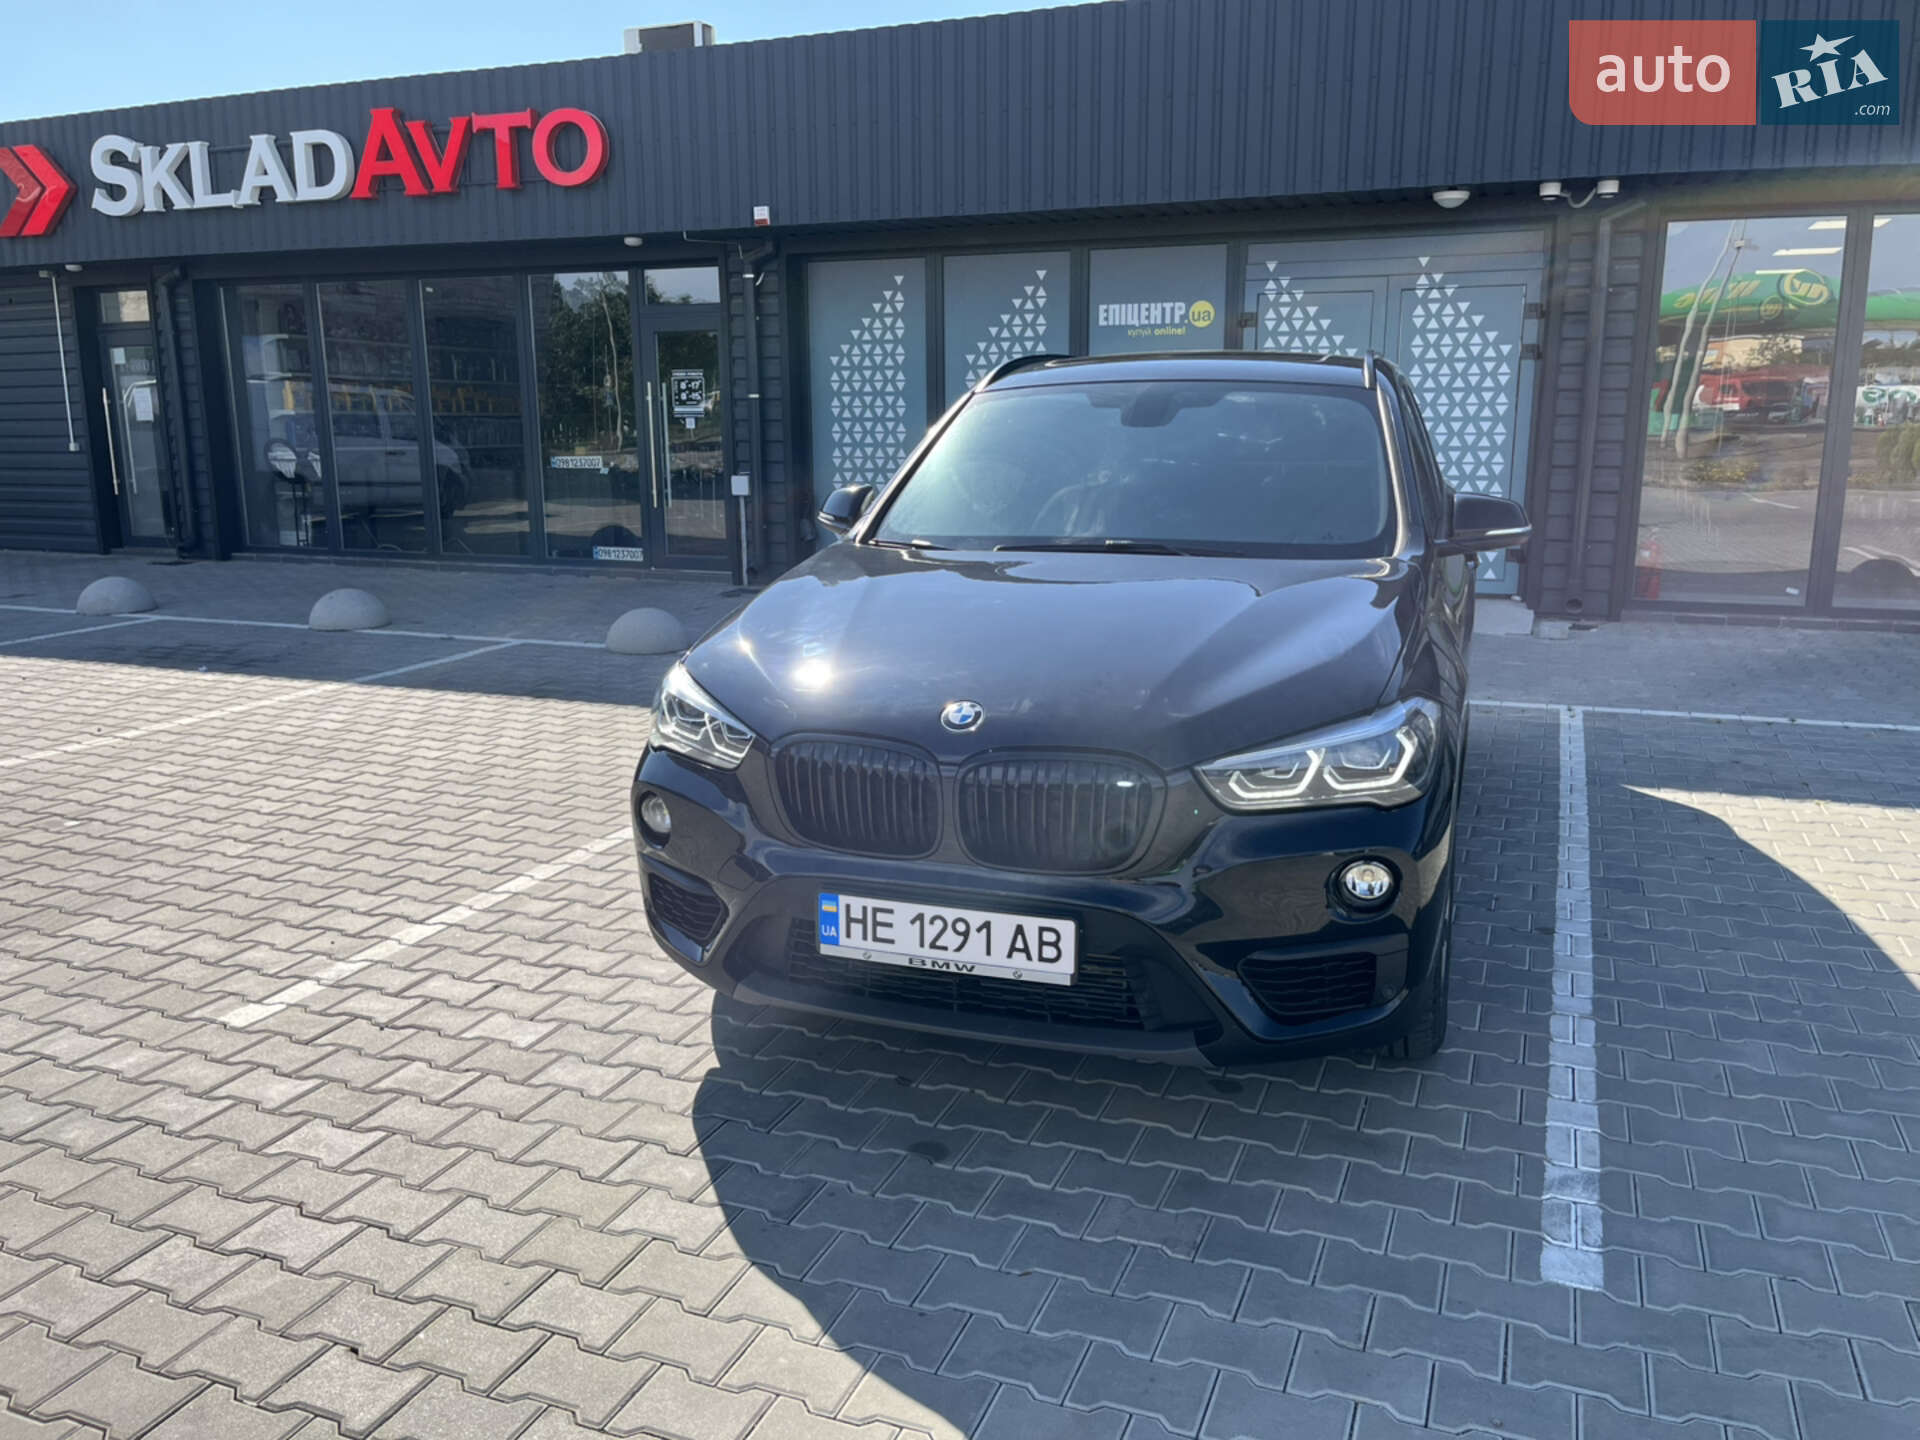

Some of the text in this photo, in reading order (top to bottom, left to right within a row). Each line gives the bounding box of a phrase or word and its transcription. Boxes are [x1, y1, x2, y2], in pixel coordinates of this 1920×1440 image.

[821, 925, 837, 937] UA
[845, 903, 1062, 964] HE 1291 AB
[908, 957, 975, 973] BMW
